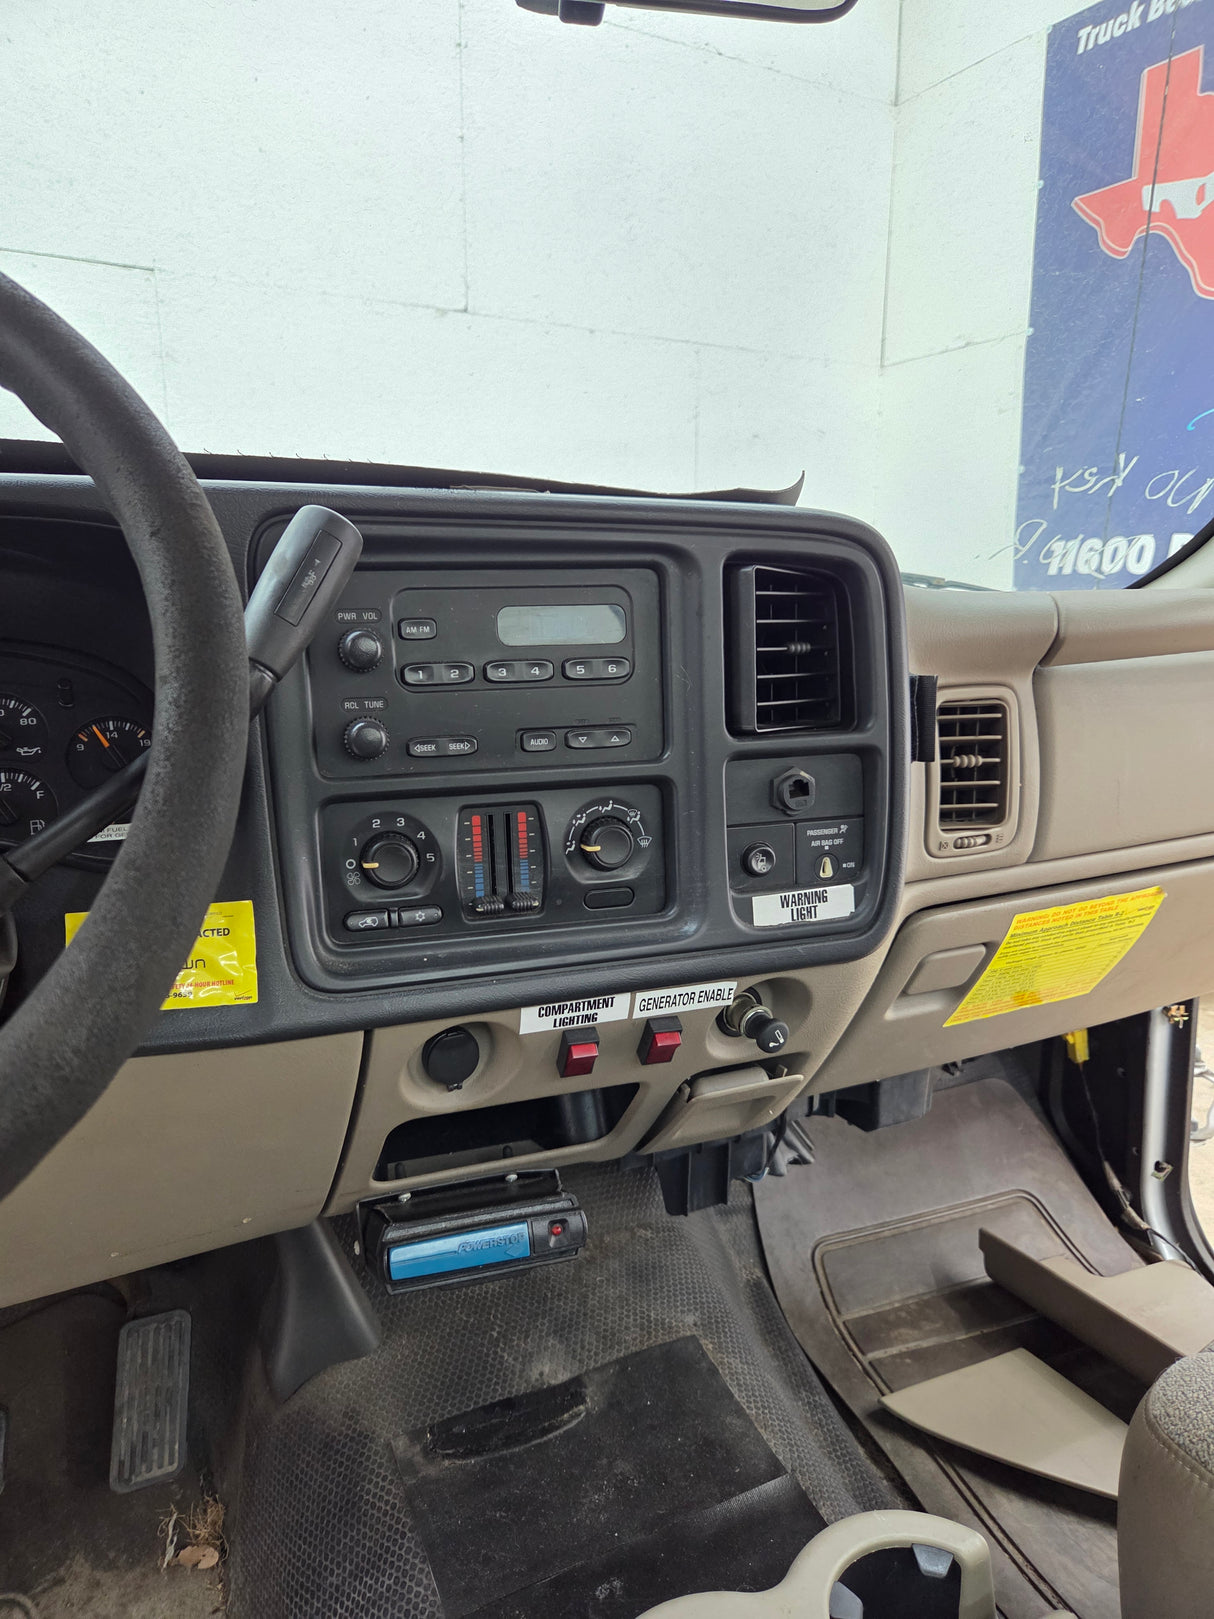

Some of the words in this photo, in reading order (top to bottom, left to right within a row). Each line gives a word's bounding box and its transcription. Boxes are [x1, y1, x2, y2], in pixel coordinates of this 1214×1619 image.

[1077, 0, 1145, 55] Truck
[1047, 534, 1156, 577] 11600
[337, 612, 357, 620] PWR
[362, 612, 378, 620] VOL
[498, 668, 507, 677] 3
[530, 666, 540, 675] 4
[576, 665, 585, 674] 5
[608, 664, 617, 673] 6
[417, 670, 423, 679] 1
[450, 669, 459, 678] 2
[344, 701, 359, 710] RCL
[364, 700, 384, 708] TUNE
[19, 717, 37, 726] 80
[105, 731, 118, 739] 14
[139, 738, 151, 747] 19
[530, 738, 549, 746] AUDIO
[76, 743, 85, 751] 9
[420, 744, 436, 752] SEEK
[448, 743, 465, 751] SEEK
[36, 790, 45, 800] F
[372, 819, 381, 828] 2
[396, 817, 405, 827] 3
[416, 831, 426, 840] 4
[806, 828, 838, 836] PASSENGER
[353, 838, 358, 846] 1
[426, 853, 435, 862] 5
[779, 889, 829, 909] WARNING
[790, 905, 818, 922] LIGHT
[211, 979, 235, 987] HOTLINE
[638, 991, 696, 1012] GENERATOR
[697, 987, 735, 1004] ENABLE
[537, 995, 616, 1018] COMPARTMENT
[553, 1012, 598, 1028] LIGHTING
[456, 1231, 527, 1255] POWERSTOP
